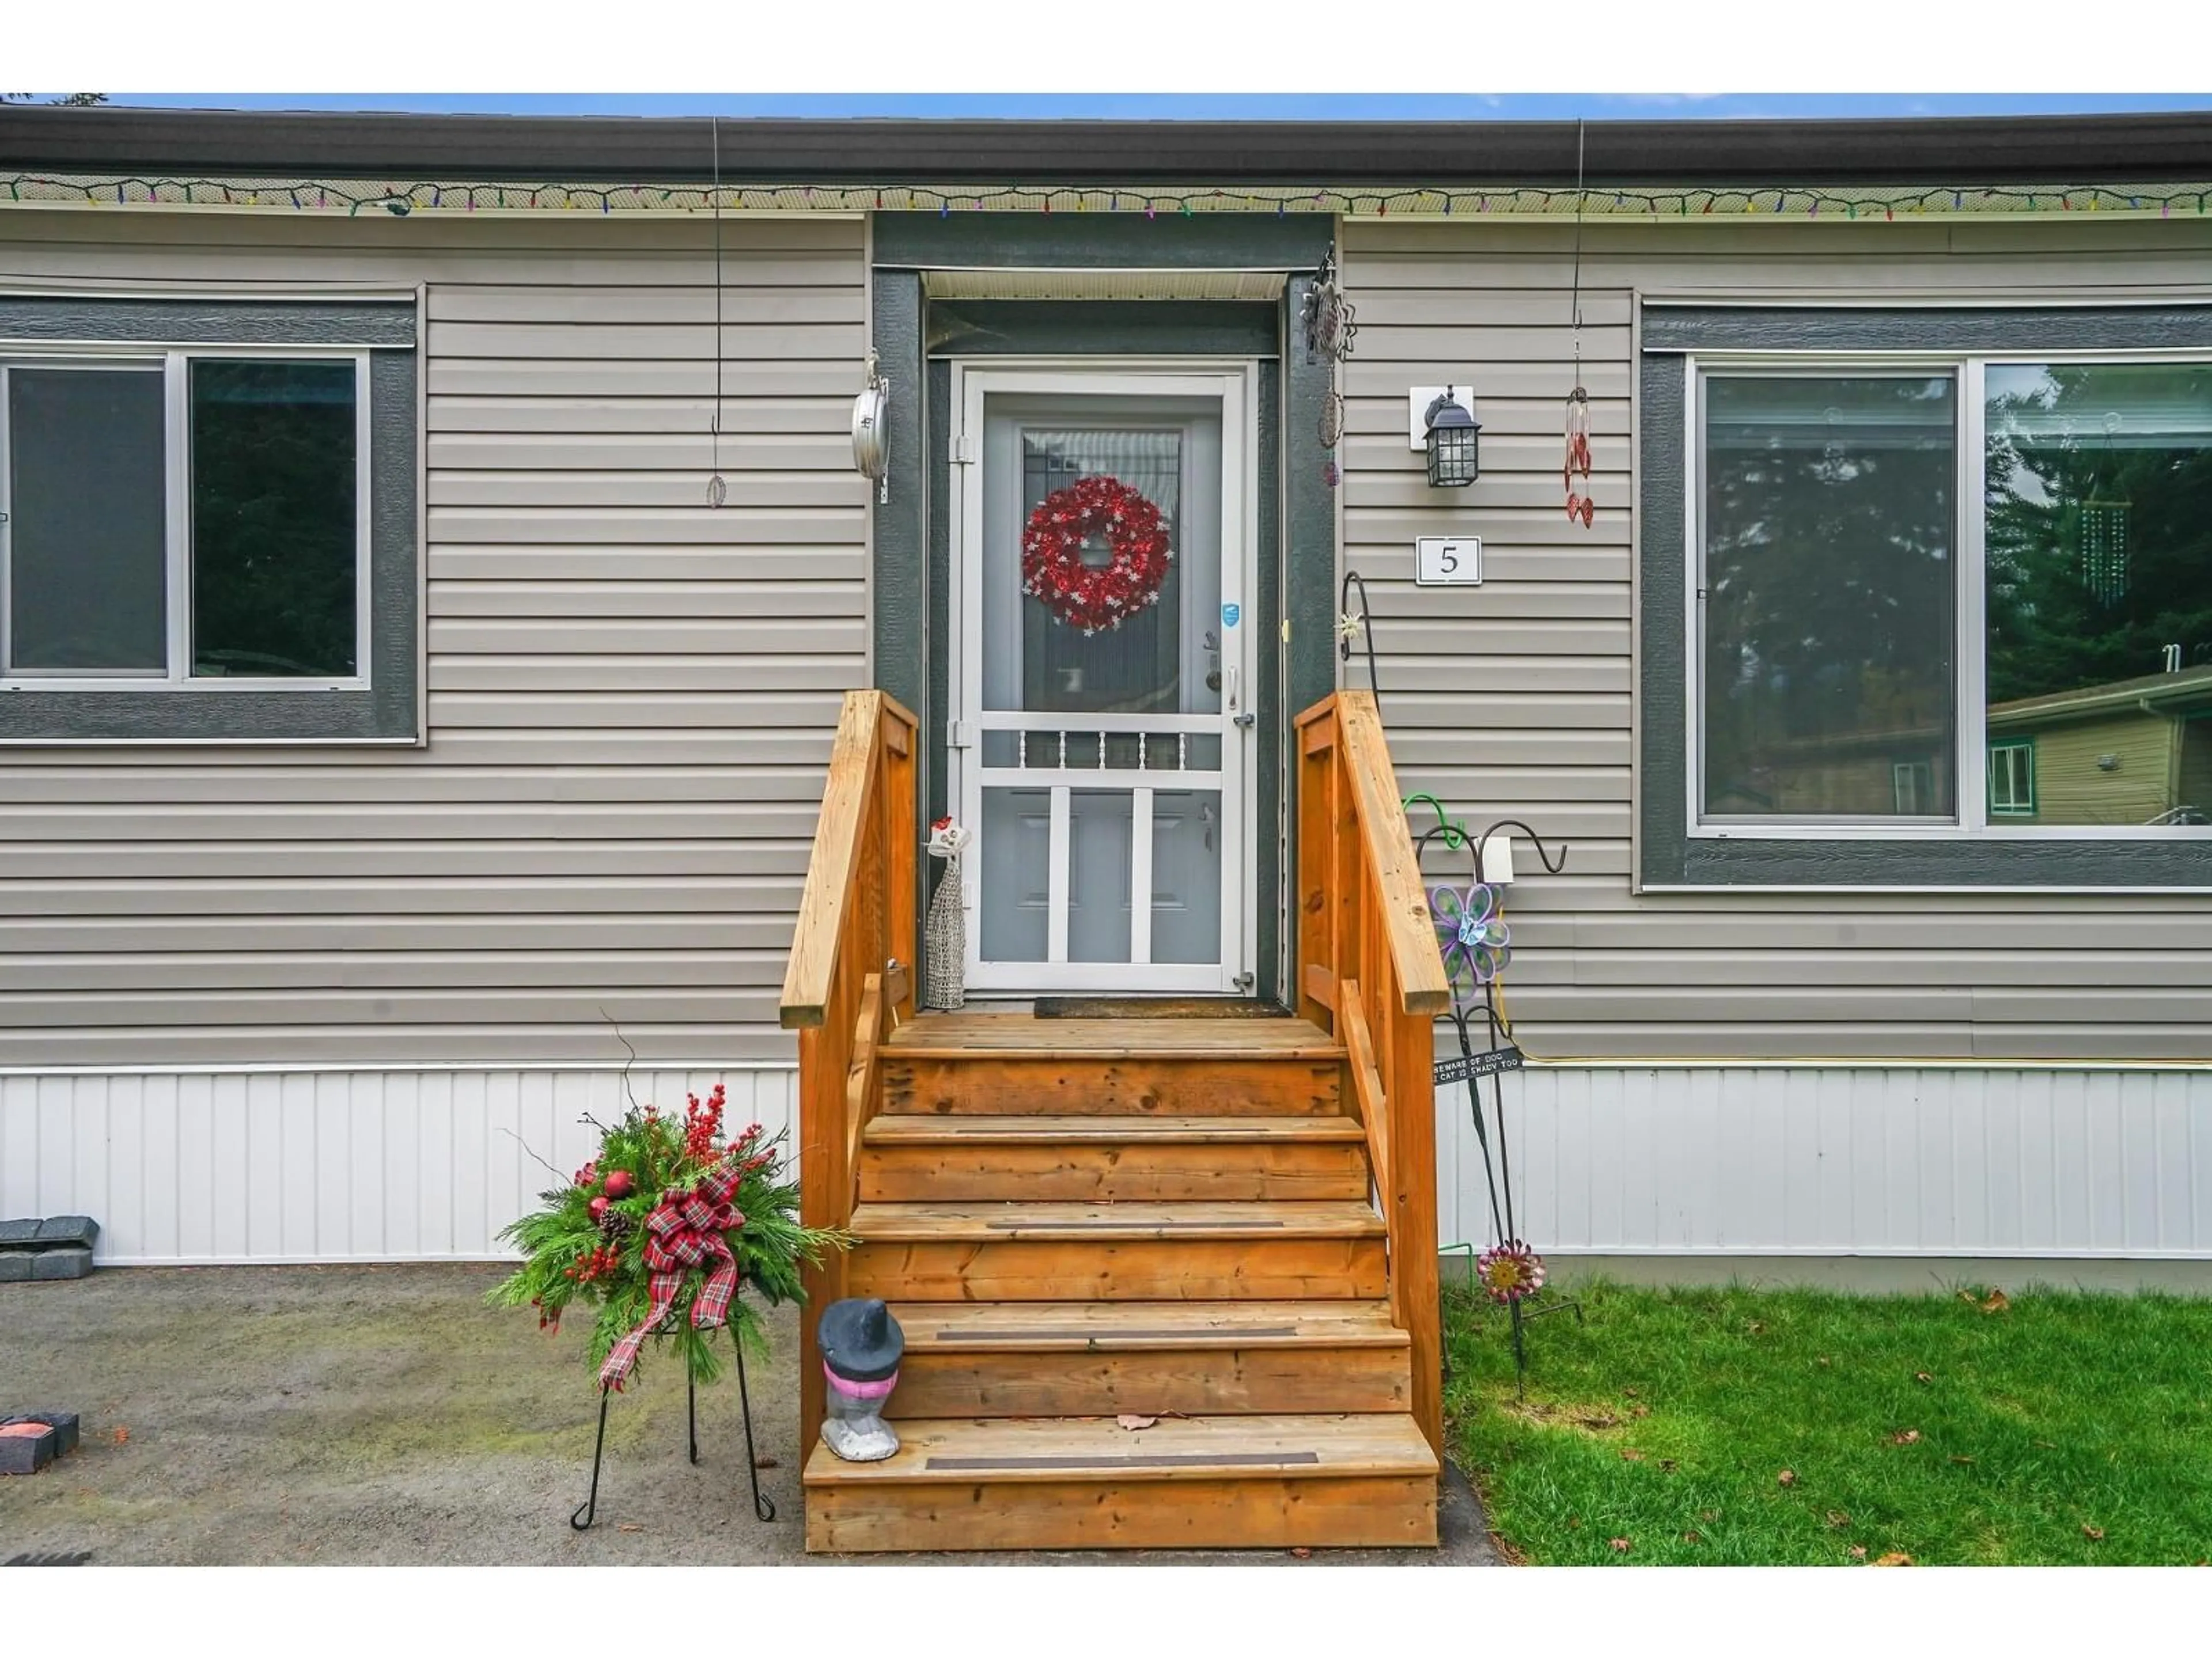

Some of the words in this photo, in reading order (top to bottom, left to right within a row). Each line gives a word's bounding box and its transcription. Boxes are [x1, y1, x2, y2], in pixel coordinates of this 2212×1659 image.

[1441, 546, 1458, 573] 5
[1433, 1060, 1467, 1074] BEWARE
[1469, 1058, 1480, 1066] OF
[1484, 1053, 1502, 1063] DOG
[1440, 1071, 1456, 1081] CAT
[1471, 1062, 1497, 1074] SHADY
[1501, 1059, 1518, 1069] TOO
